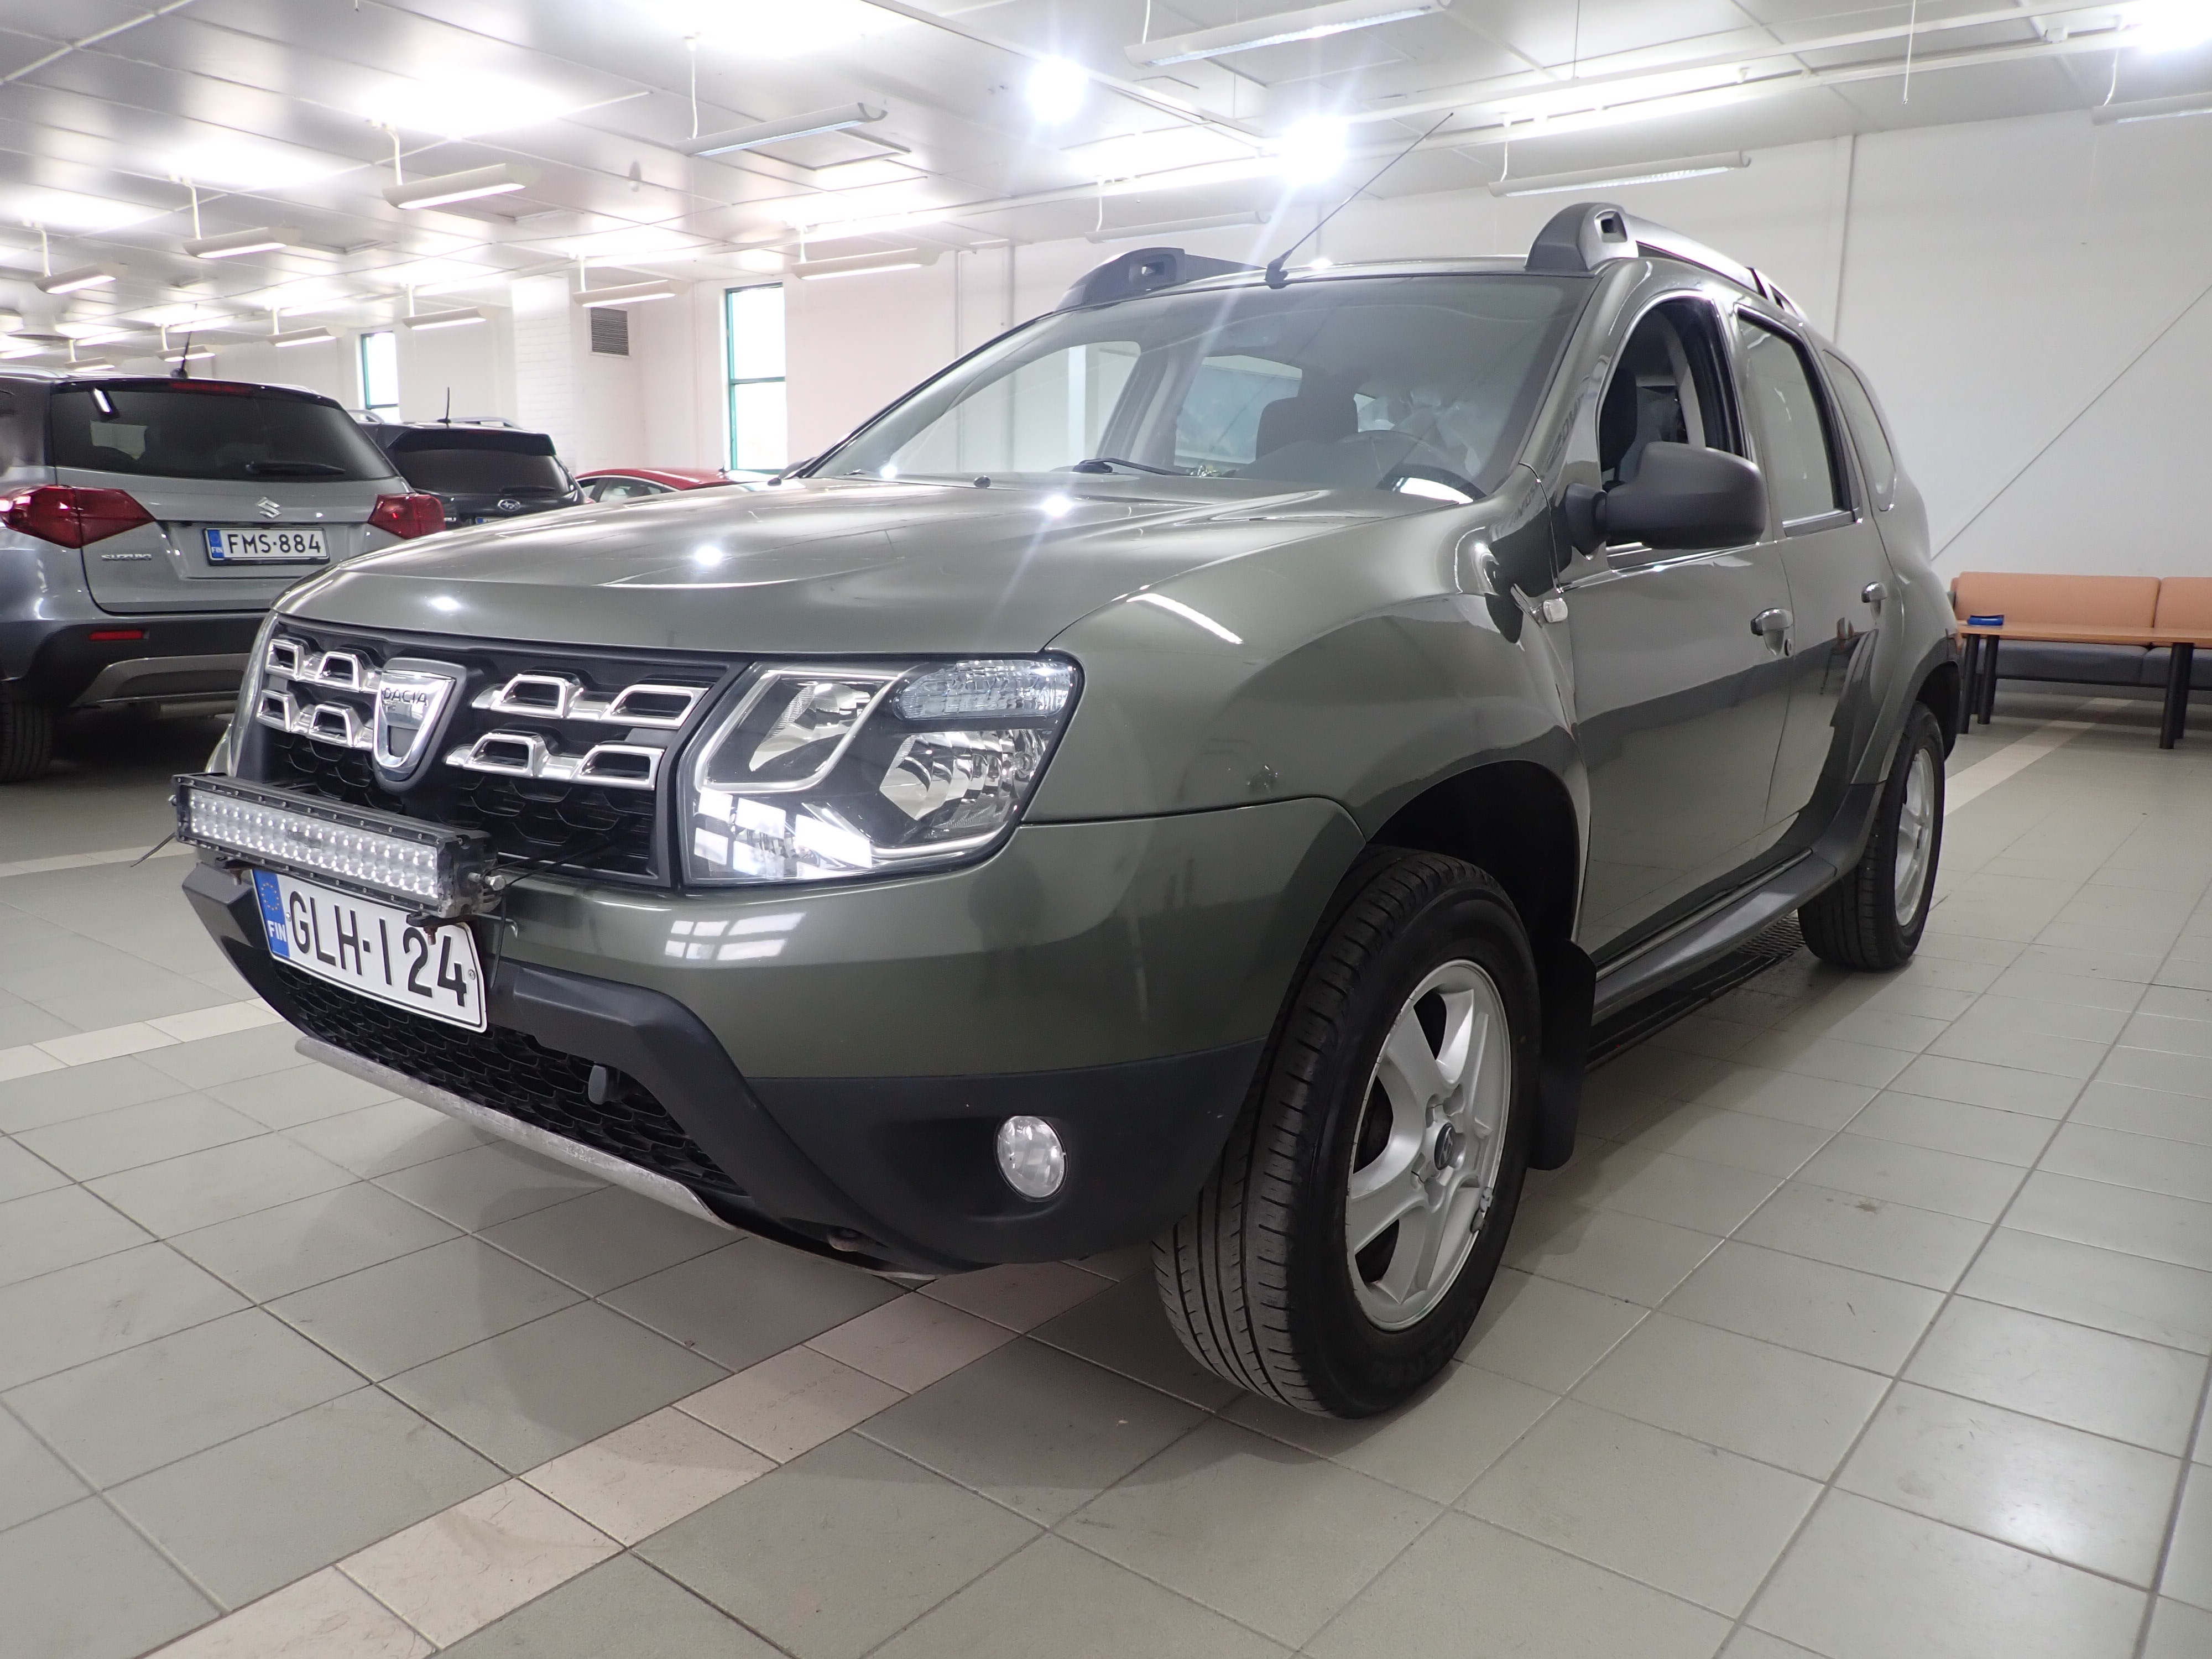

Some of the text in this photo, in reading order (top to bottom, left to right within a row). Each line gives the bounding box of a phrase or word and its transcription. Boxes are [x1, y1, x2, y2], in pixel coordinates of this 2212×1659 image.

[227, 534, 321, 553] FMS-884
[383, 688, 429, 706] DACIA
[267, 919, 287, 942] FIN
[289, 890, 467, 1008] GLH-124
